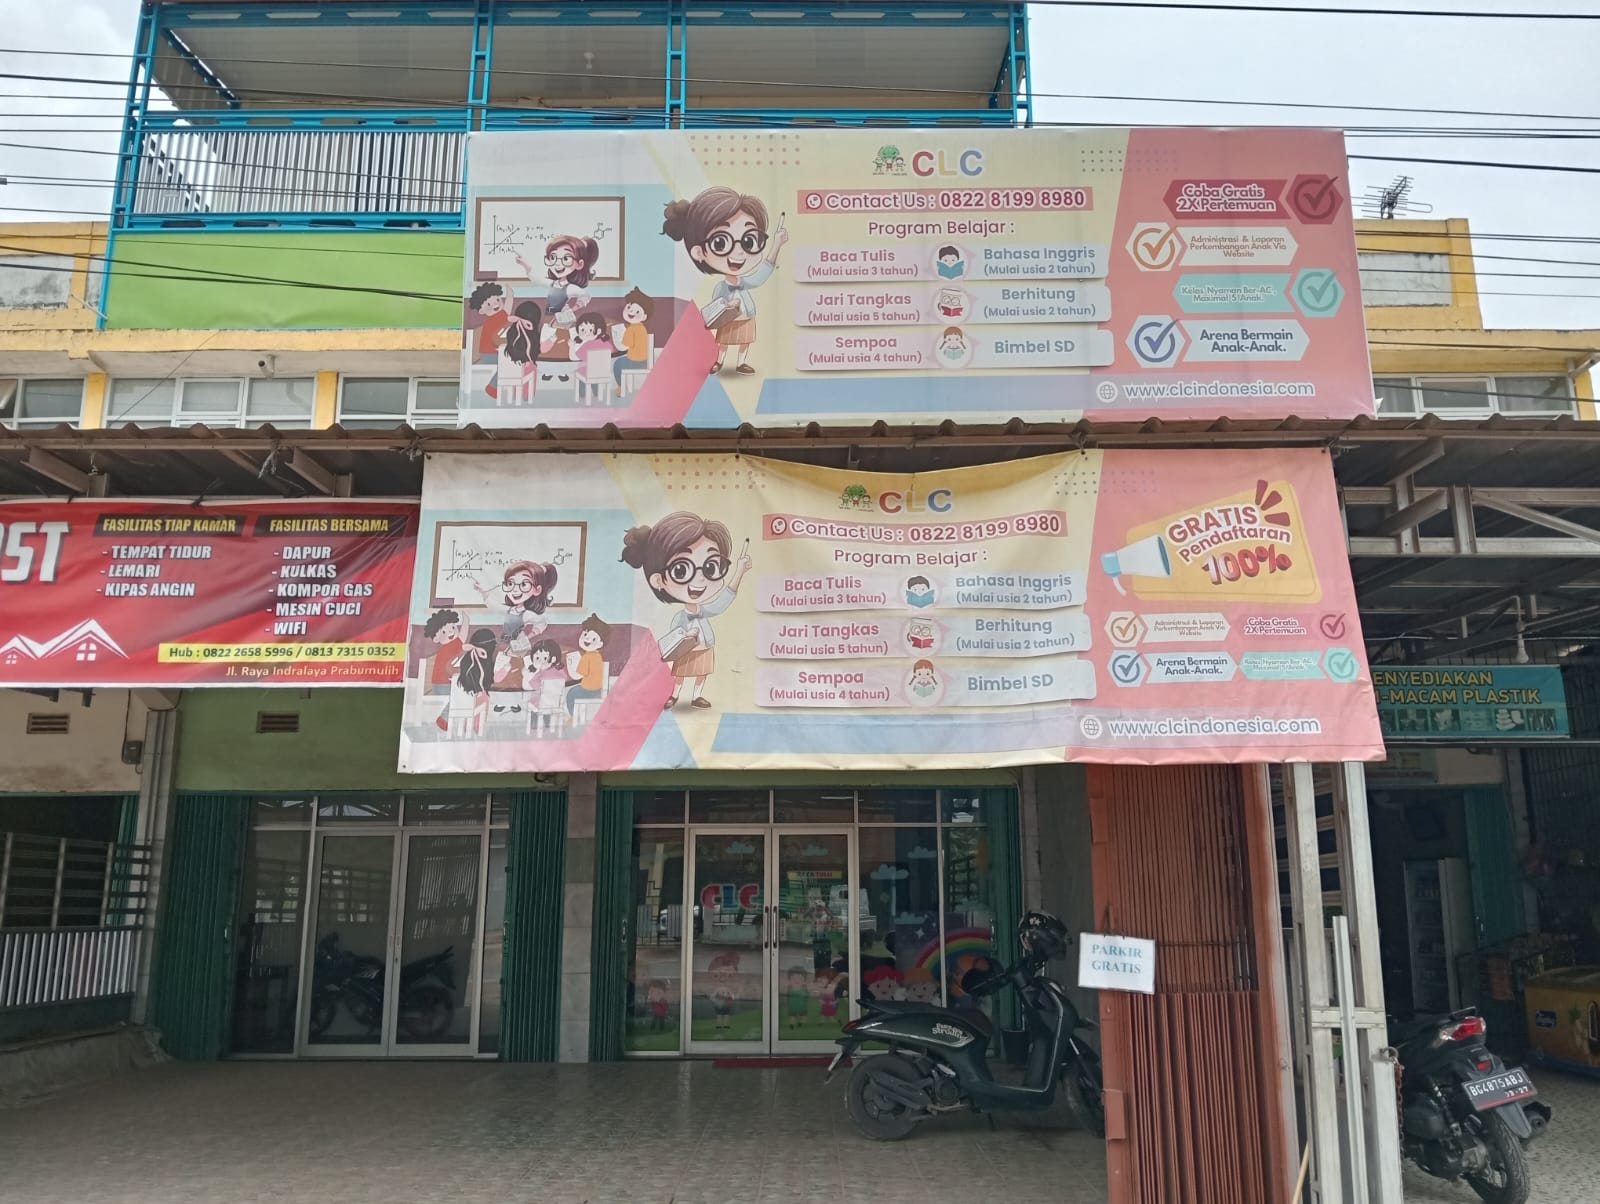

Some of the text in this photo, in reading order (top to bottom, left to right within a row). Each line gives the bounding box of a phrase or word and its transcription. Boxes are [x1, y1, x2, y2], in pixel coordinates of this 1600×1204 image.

[912, 150, 983, 176] CLC
[1183, 184, 1264, 198] Coba Gratis
[826, 194, 899, 209] Contact
[941, 192, 984, 208] 0822
[991, 192, 1034, 207] 8199
[1041, 191, 1084, 207] 8980
[1177, 199, 1275, 210] 2X Pertemuan
[868, 222, 942, 239] Program
[1190, 235, 1239, 243] Administrasi
[1252, 235, 1285, 244] Laporan
[984, 247, 1096, 262] Bahasa Inggris
[1190, 243, 1249, 253] Perkembangan
[1223, 250, 1255, 258] Website
[820, 250, 896, 263] Baca Tulis
[807, 264, 919, 277] (Mulai usia 3 tahun)
[984, 262, 1096, 277] (Mulai usia 2 tahun)
[816, 292, 912, 308] Jari Tangkas
[1001, 288, 1076, 304] Berhitung
[808, 309, 920, 323] (Mulai usia 5 tahun)
[983, 304, 1096, 318] (Mulai usia 2 tahun)
[1199, 328, 1294, 341] Arena Bermain
[835, 336, 897, 351] Sempoa
[994, 340, 1075, 354] Bimbel SD
[1211, 340, 1287, 353] Anak-Anak.
[808, 352, 922, 365] (Mulai usia 4 tahun)
[1125, 381, 1315, 398] www.clcindonesia.com
[878, 489, 952, 514] CLC
[103, 518, 237, 532] FASILITAS TIAP KAMAR
[269, 519, 389, 532] FASILITAS BERSAMA
[791, 520, 866, 539] Contact
[910, 527, 956, 541] 0822
[962, 522, 1009, 540] 8199
[1015, 515, 1060, 533] 8980
[1168, 505, 1258, 543] GRATIS
[0, 521, 69, 582] ST
[168, 545, 212, 559] TIDUR
[1179, 526, 1291, 563] Pendaftaran
[834, 549, 911, 567] Program
[1202, 543, 1293, 585] 100%
[149, 583, 196, 597] ANGIN
[342, 583, 374, 597] GAS
[784, 576, 862, 592] Baca Tulis
[956, 574, 1072, 592] Bahasa Inggris
[770, 592, 887, 608] (Mulai usia 3 tahun)
[956, 588, 1073, 605] (Mulai usia 2 tahun)
[324, 602, 362, 616] CUCI
[975, 618, 1053, 635] Berhitung
[1247, 618, 1298, 627] Coba Gratis
[778, 623, 880, 641] Jari Tangkas
[1244, 627, 1306, 635] 2X Pertemuan
[770, 641, 889, 657] (Mulai usia 5 tahun)
[956, 633, 1076, 652] (Mulai usia 2 tahun)
[203, 648, 232, 658] 0822
[234, 647, 262, 658] 2658
[264, 647, 293, 658] 5996
[305, 647, 334, 658] 0813
[336, 646, 364, 657] 7315
[366, 646, 396, 657] 0352
[1156, 656, 1228, 667] Arena Bermain
[241, 666, 269, 678] Raya
[272, 665, 327, 678] Indralaya
[330, 665, 400, 677] Prabumulih
[1164, 666, 1223, 676] Anak-Anak.
[1372, 671, 1493, 686] ENYEDIAKAN
[798, 671, 864, 687] Sempoa
[967, 674, 1054, 692] Bimbel SD
[769, 687, 891, 702] (Mulai usia 4 tahun)
[1462, 688, 1541, 704] PLASTIK
[1110, 718, 1320, 735] www.clcindonesia.com
[702, 884, 759, 910] CLC
[1092, 943, 1142, 958] PARKIR
[1092, 960, 1142, 974] GRATIS
